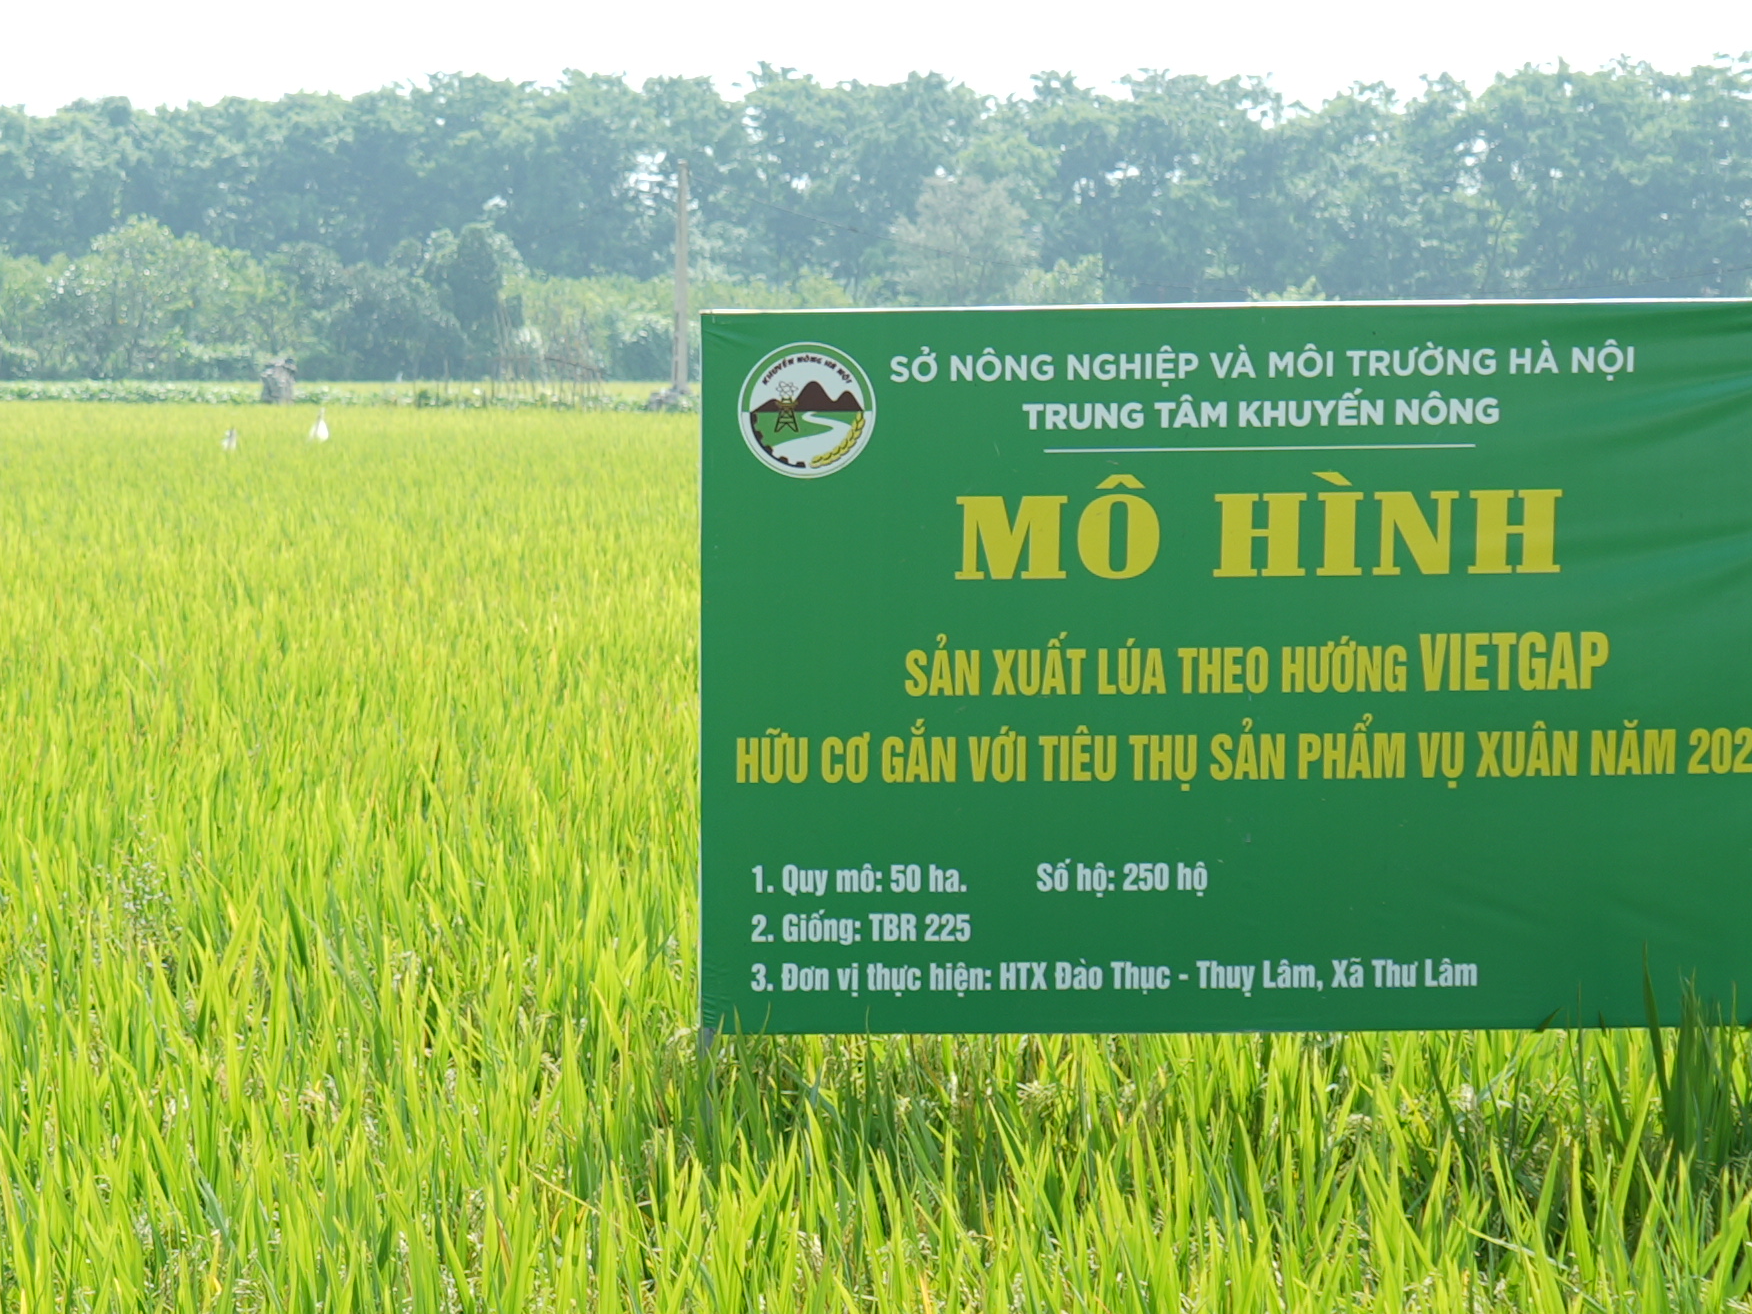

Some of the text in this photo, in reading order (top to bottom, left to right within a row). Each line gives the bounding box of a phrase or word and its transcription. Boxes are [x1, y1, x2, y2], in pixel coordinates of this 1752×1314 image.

[889, 337, 1635, 388] SỞ NÔNG NGHIỆP VÀ MÔI TRƯỜNG HÀ NỘI
[1021, 387, 1501, 431] TRUNG TÂM KHUYẾN NÔNG
[954, 470, 1564, 581] MÔ HÌNH
[904, 630, 1610, 697] SẢN XUẤT LÚA THEO HƯỚNG VIETGAP
[736, 727, 809, 784] HỮU
[820, 731, 871, 784] CƠ
[881, 718, 957, 784] GẮN
[967, 725, 1027, 783] VỚI
[1038, 724, 1118, 782] TIÊU
[1128, 734, 1198, 792] THỤ
[1209, 717, 1286, 781] SẢN
[1297, 712, 1407, 780] PHẨM
[1417, 731, 1465, 789] VỤ
[1476, 720, 1579, 778] XUÂN
[1590, 719, 1677, 776] NĂM
[751, 863, 968, 897] 1. Quy mô: 50 ha.
[1036, 858, 1208, 898] Số hộ: 250 hộ
[751, 909, 971, 946] 2. Giống: TBR 225
[750, 963, 774, 992] 3.
[780, 962, 830, 992] Đơn
[836, 962, 859, 998] vị
[866, 962, 922, 998] thực
[929, 961, 992, 998] hiện:
[999, 961, 1048, 991] HTX
[1054, 958, 1103, 991] Đào
[1110, 961, 1171, 995] Thục
[1195, 960, 1256, 998] Thuỵ
[1262, 959, 1324, 992] Lâm,
[1331, 957, 1364, 989] Xã
[1371, 959, 1419, 988] Thư
[1424, 957, 1478, 988] Lâm
